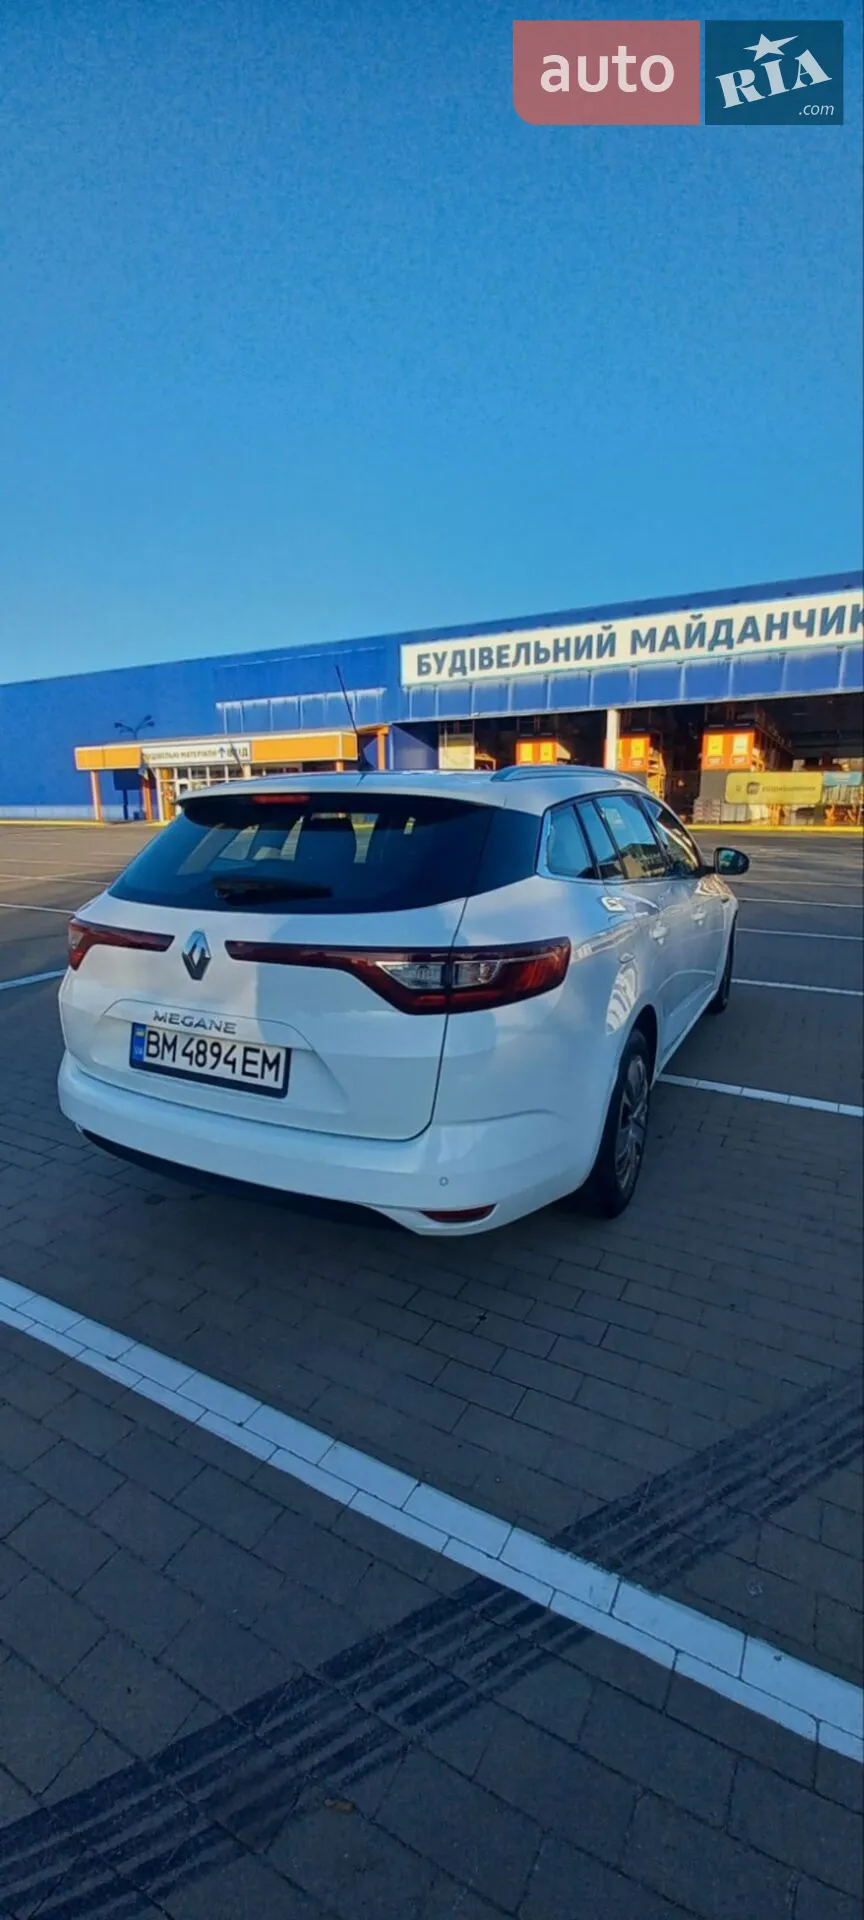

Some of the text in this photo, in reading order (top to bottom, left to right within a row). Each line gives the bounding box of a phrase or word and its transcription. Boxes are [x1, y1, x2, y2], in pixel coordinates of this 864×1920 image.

[417, 624, 617, 677] БУДІВЕЛЬНИЙ
[153, 1010, 237, 1034] MEGANE
[145, 1030, 281, 1082] BM 4894 EM
